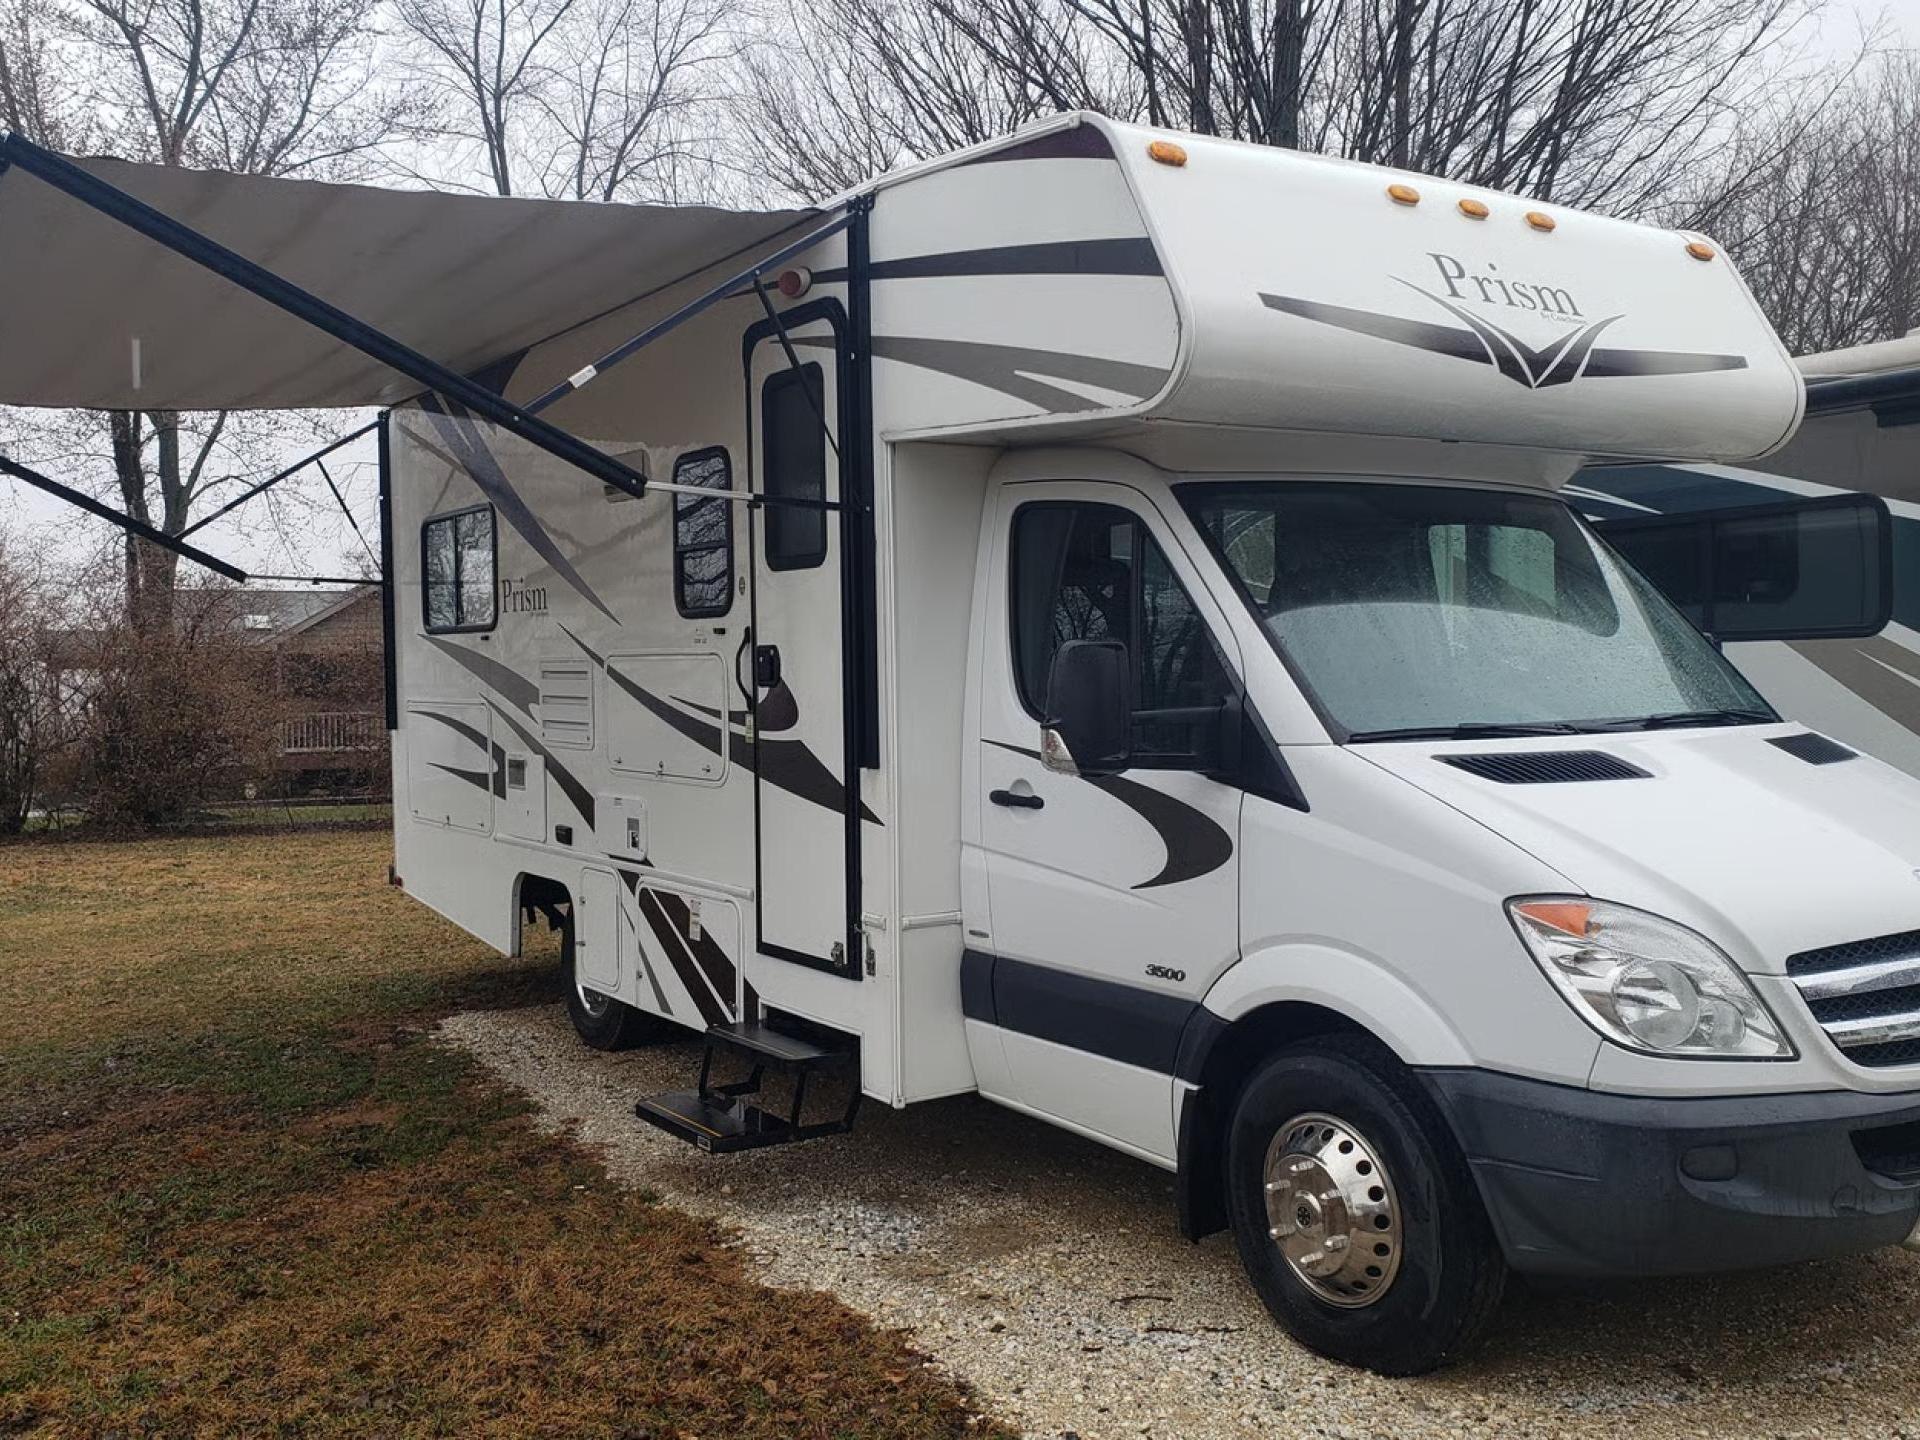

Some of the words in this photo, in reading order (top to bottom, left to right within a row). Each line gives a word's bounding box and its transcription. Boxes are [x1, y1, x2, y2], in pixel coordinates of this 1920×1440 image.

[1426, 252, 1584, 317] Prism
[502, 577, 548, 613] Prism
[1145, 963, 1186, 982] 3500
